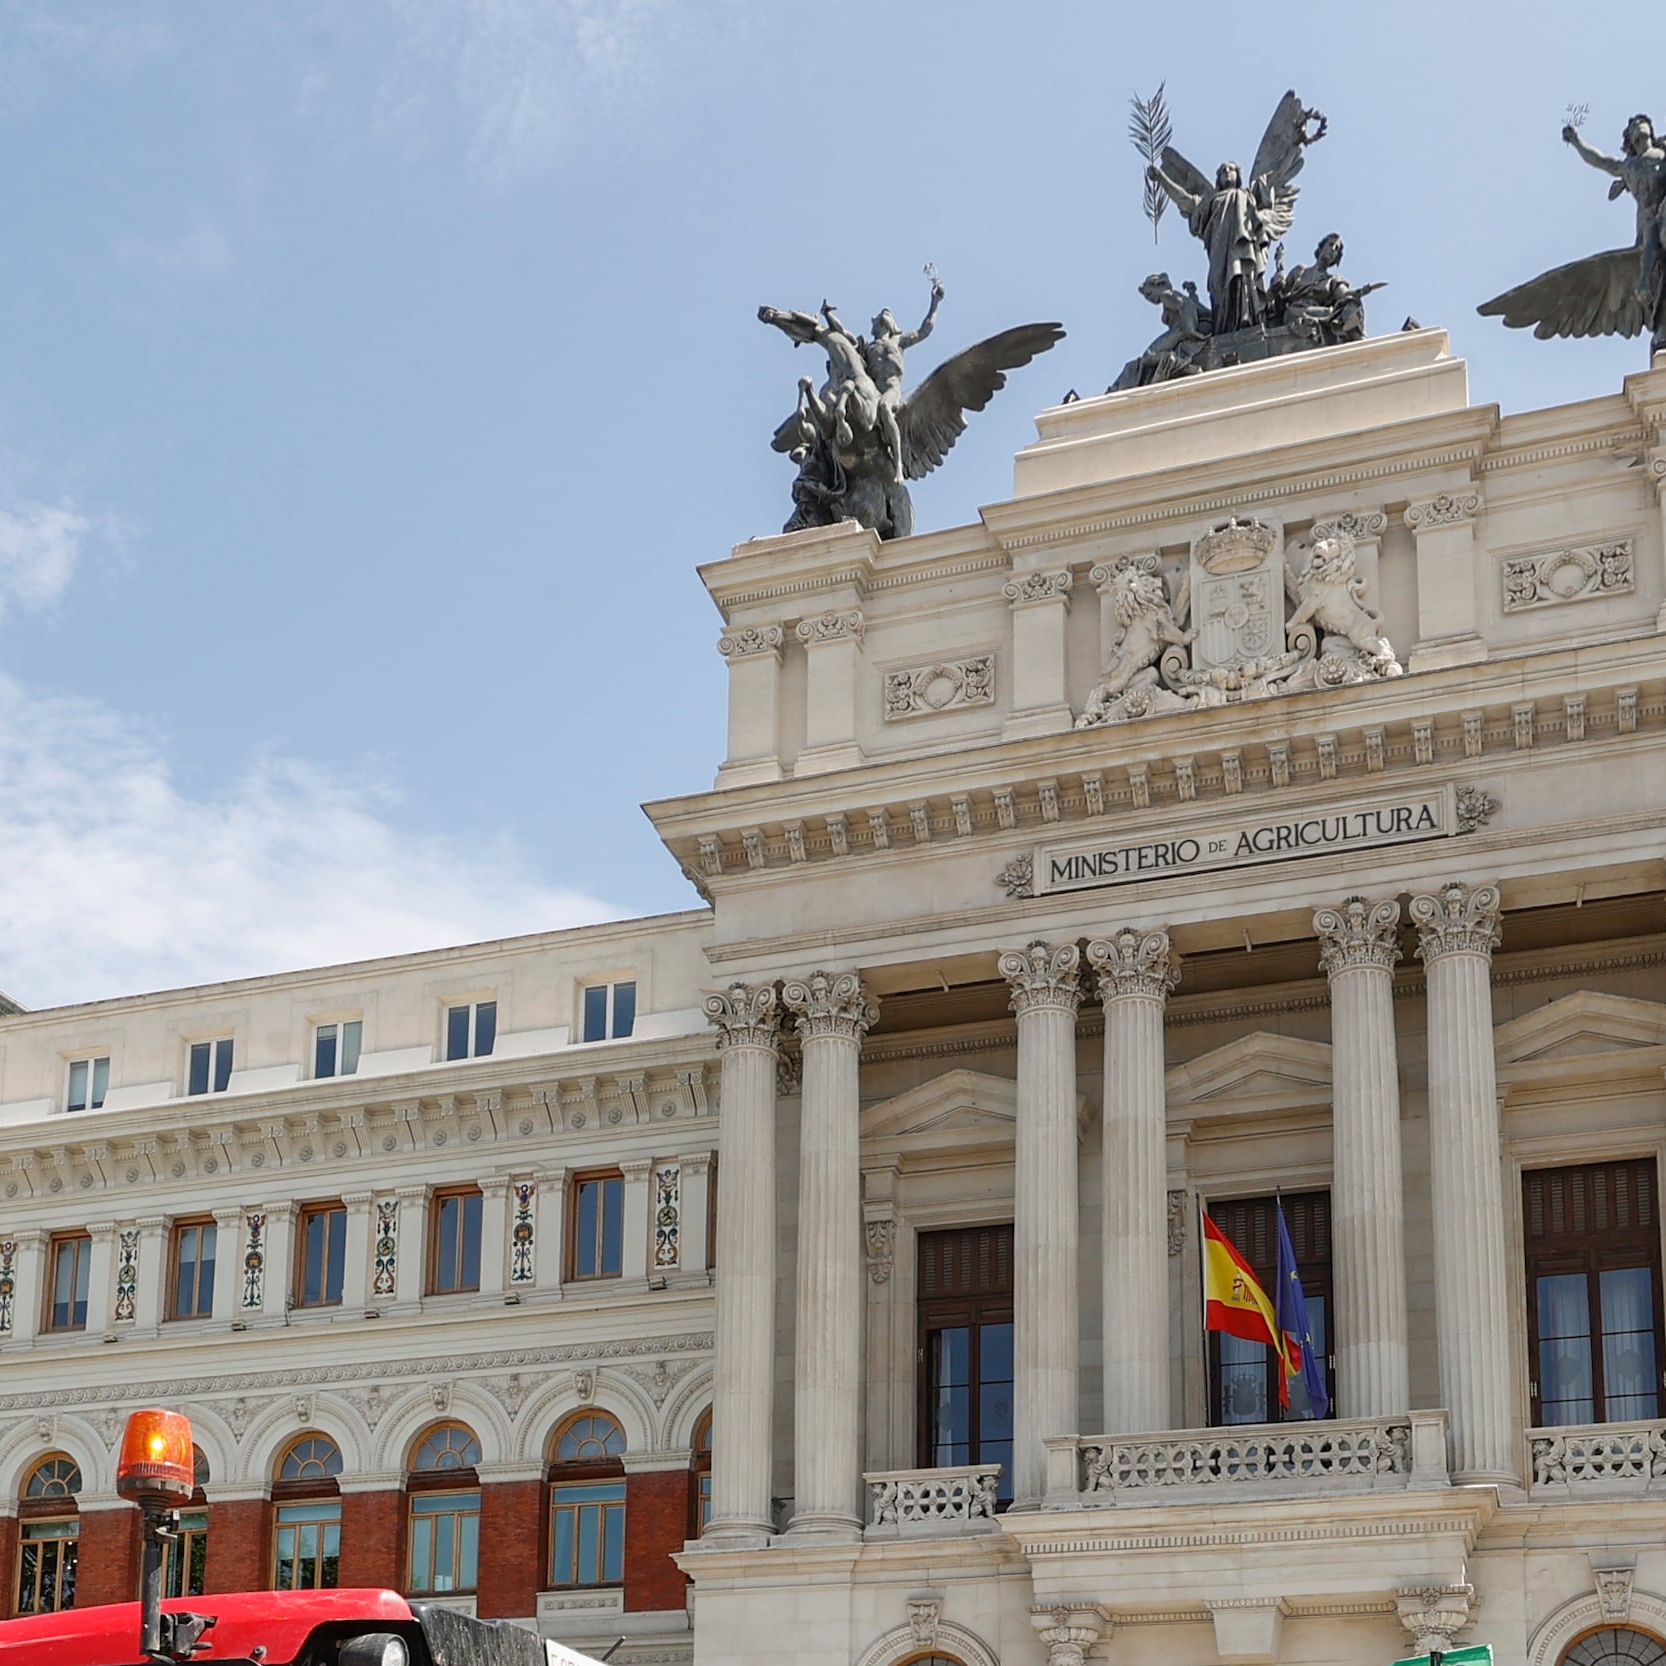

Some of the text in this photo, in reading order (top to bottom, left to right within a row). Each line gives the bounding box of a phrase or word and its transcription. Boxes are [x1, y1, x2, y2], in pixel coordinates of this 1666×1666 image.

[1050, 803, 1436, 884] MINISTERIO DE AGRICULTURA
